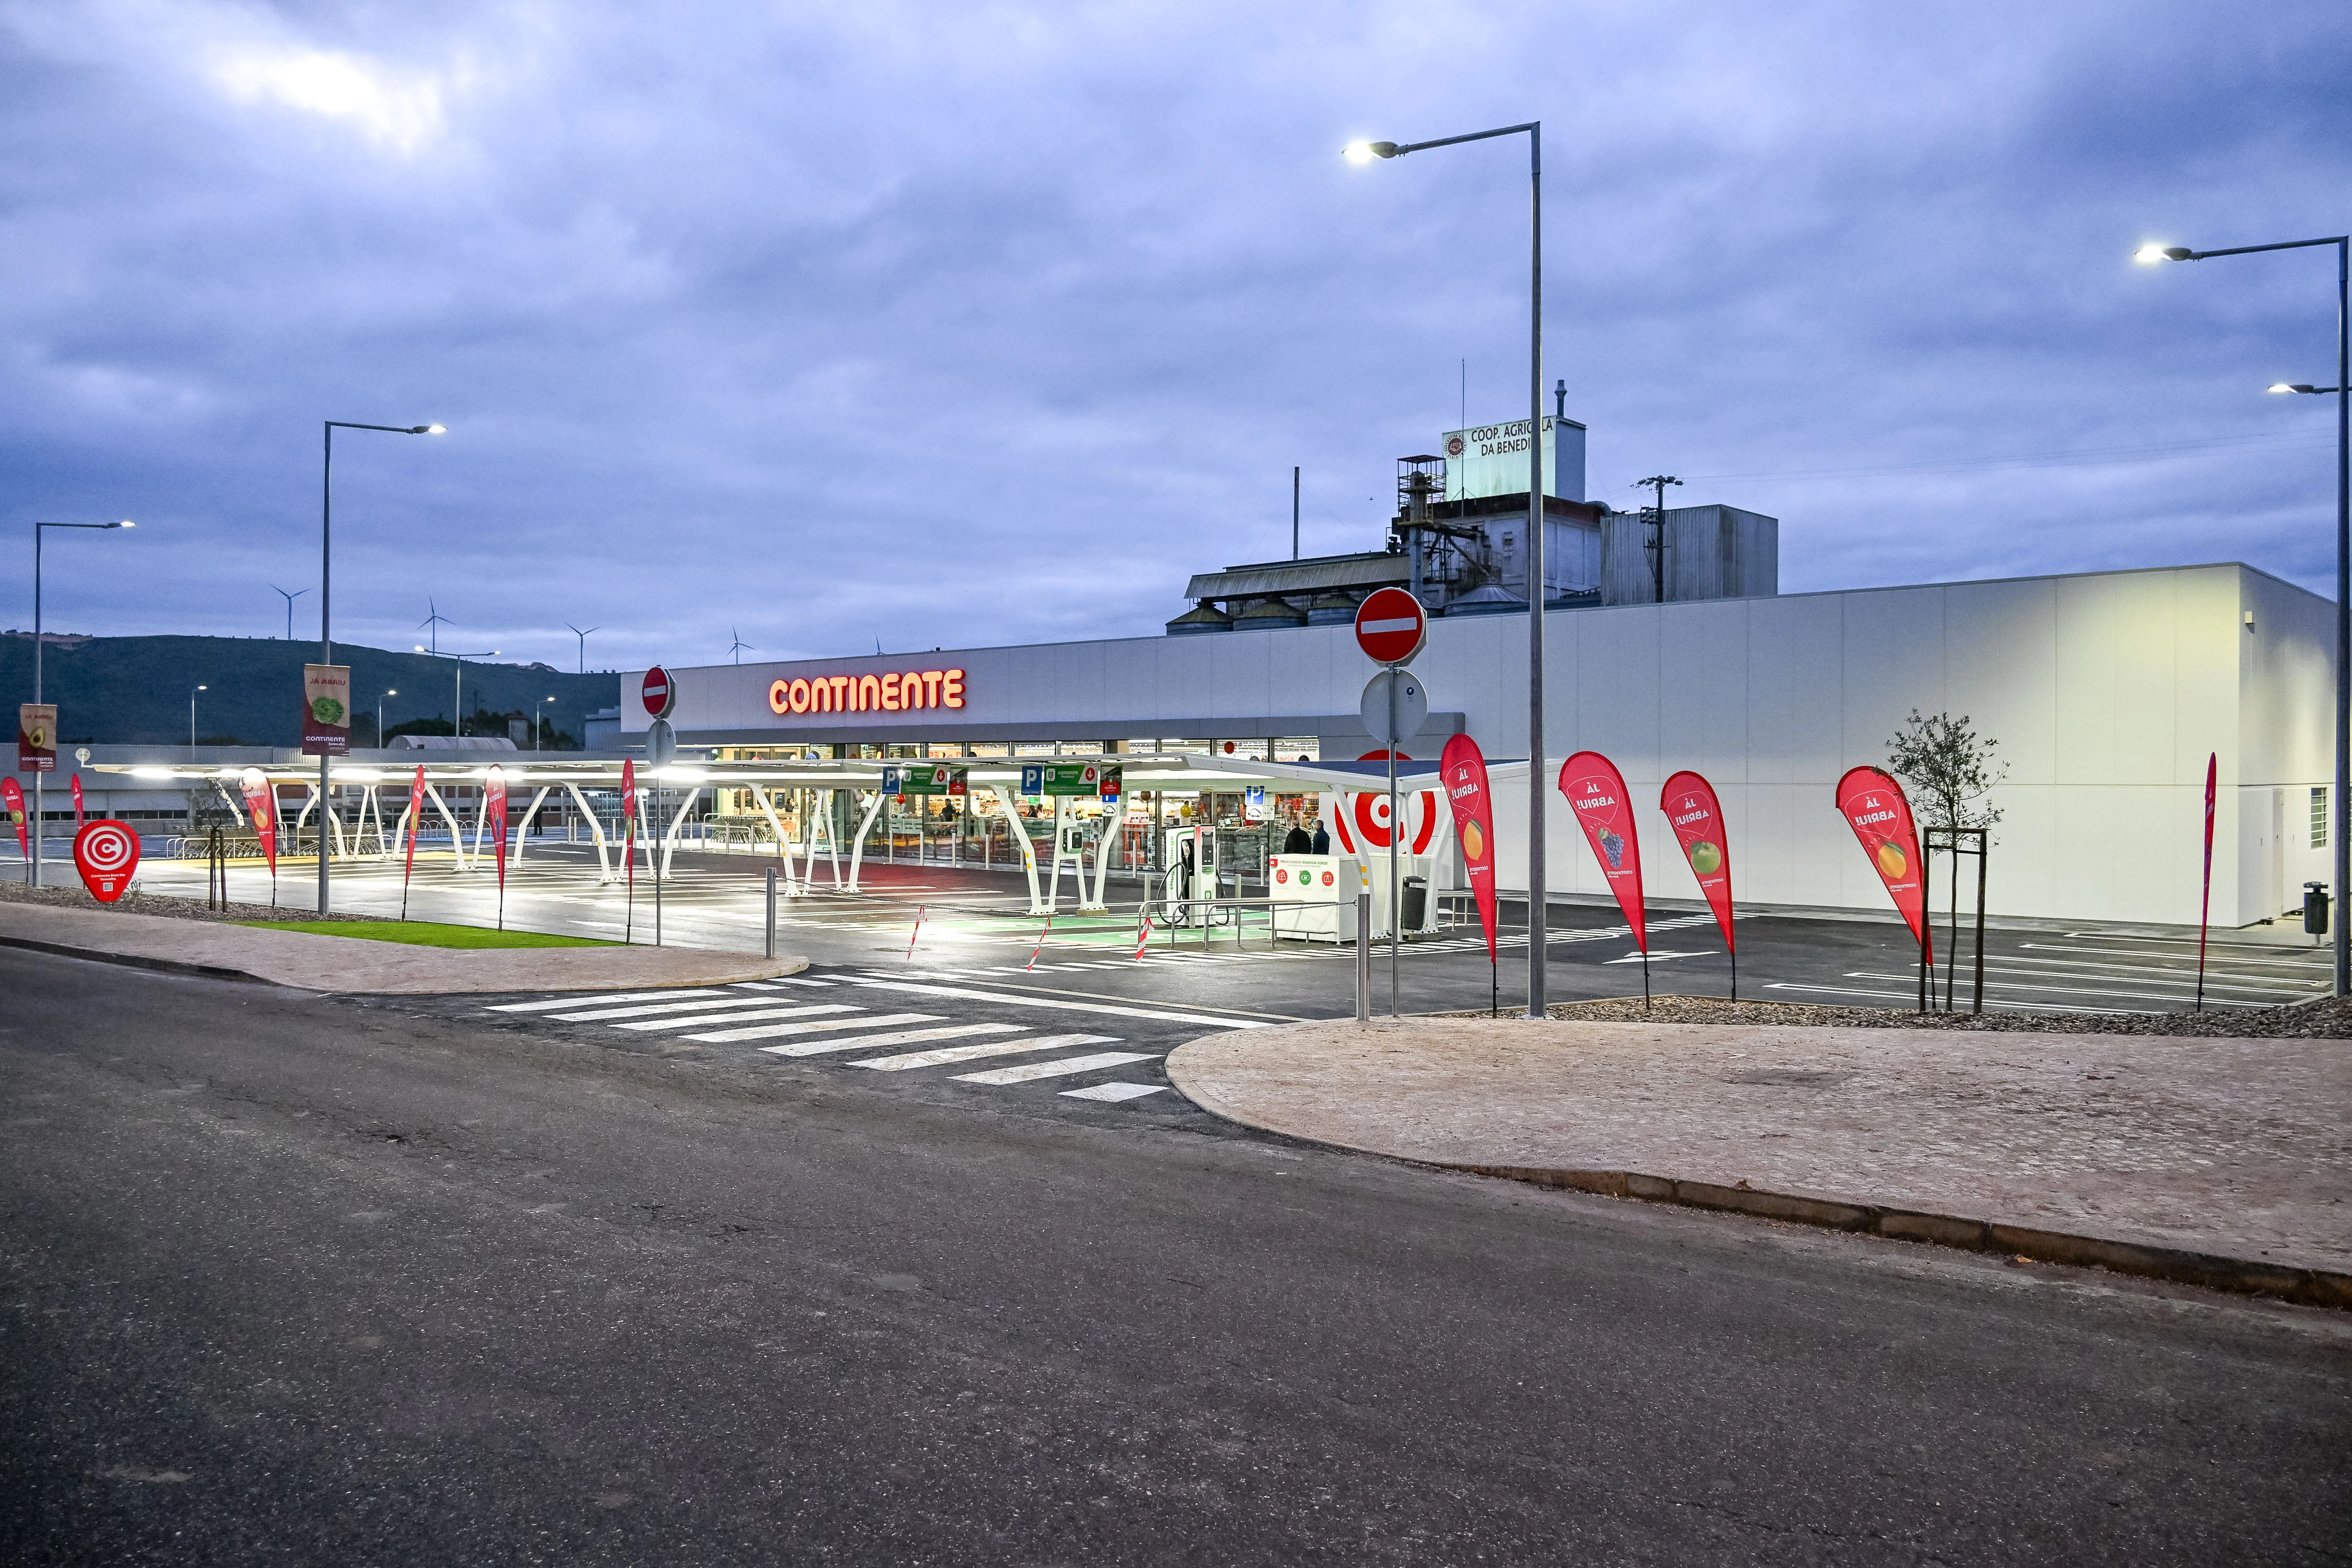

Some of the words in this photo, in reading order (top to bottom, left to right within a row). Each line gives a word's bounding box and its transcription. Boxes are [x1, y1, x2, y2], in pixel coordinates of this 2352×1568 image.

[1471, 427, 1500, 442] COOP.
[1504, 419, 1553, 438] AGRICLA
[1481, 444, 1495, 456] DA
[1497, 437, 1531, 454] BENEDI
[769, 669, 965, 714] CONTINENTE
[886, 770, 896, 787] P
[1026, 769, 1037, 787] P
[1250, 786, 1261, 803] P
